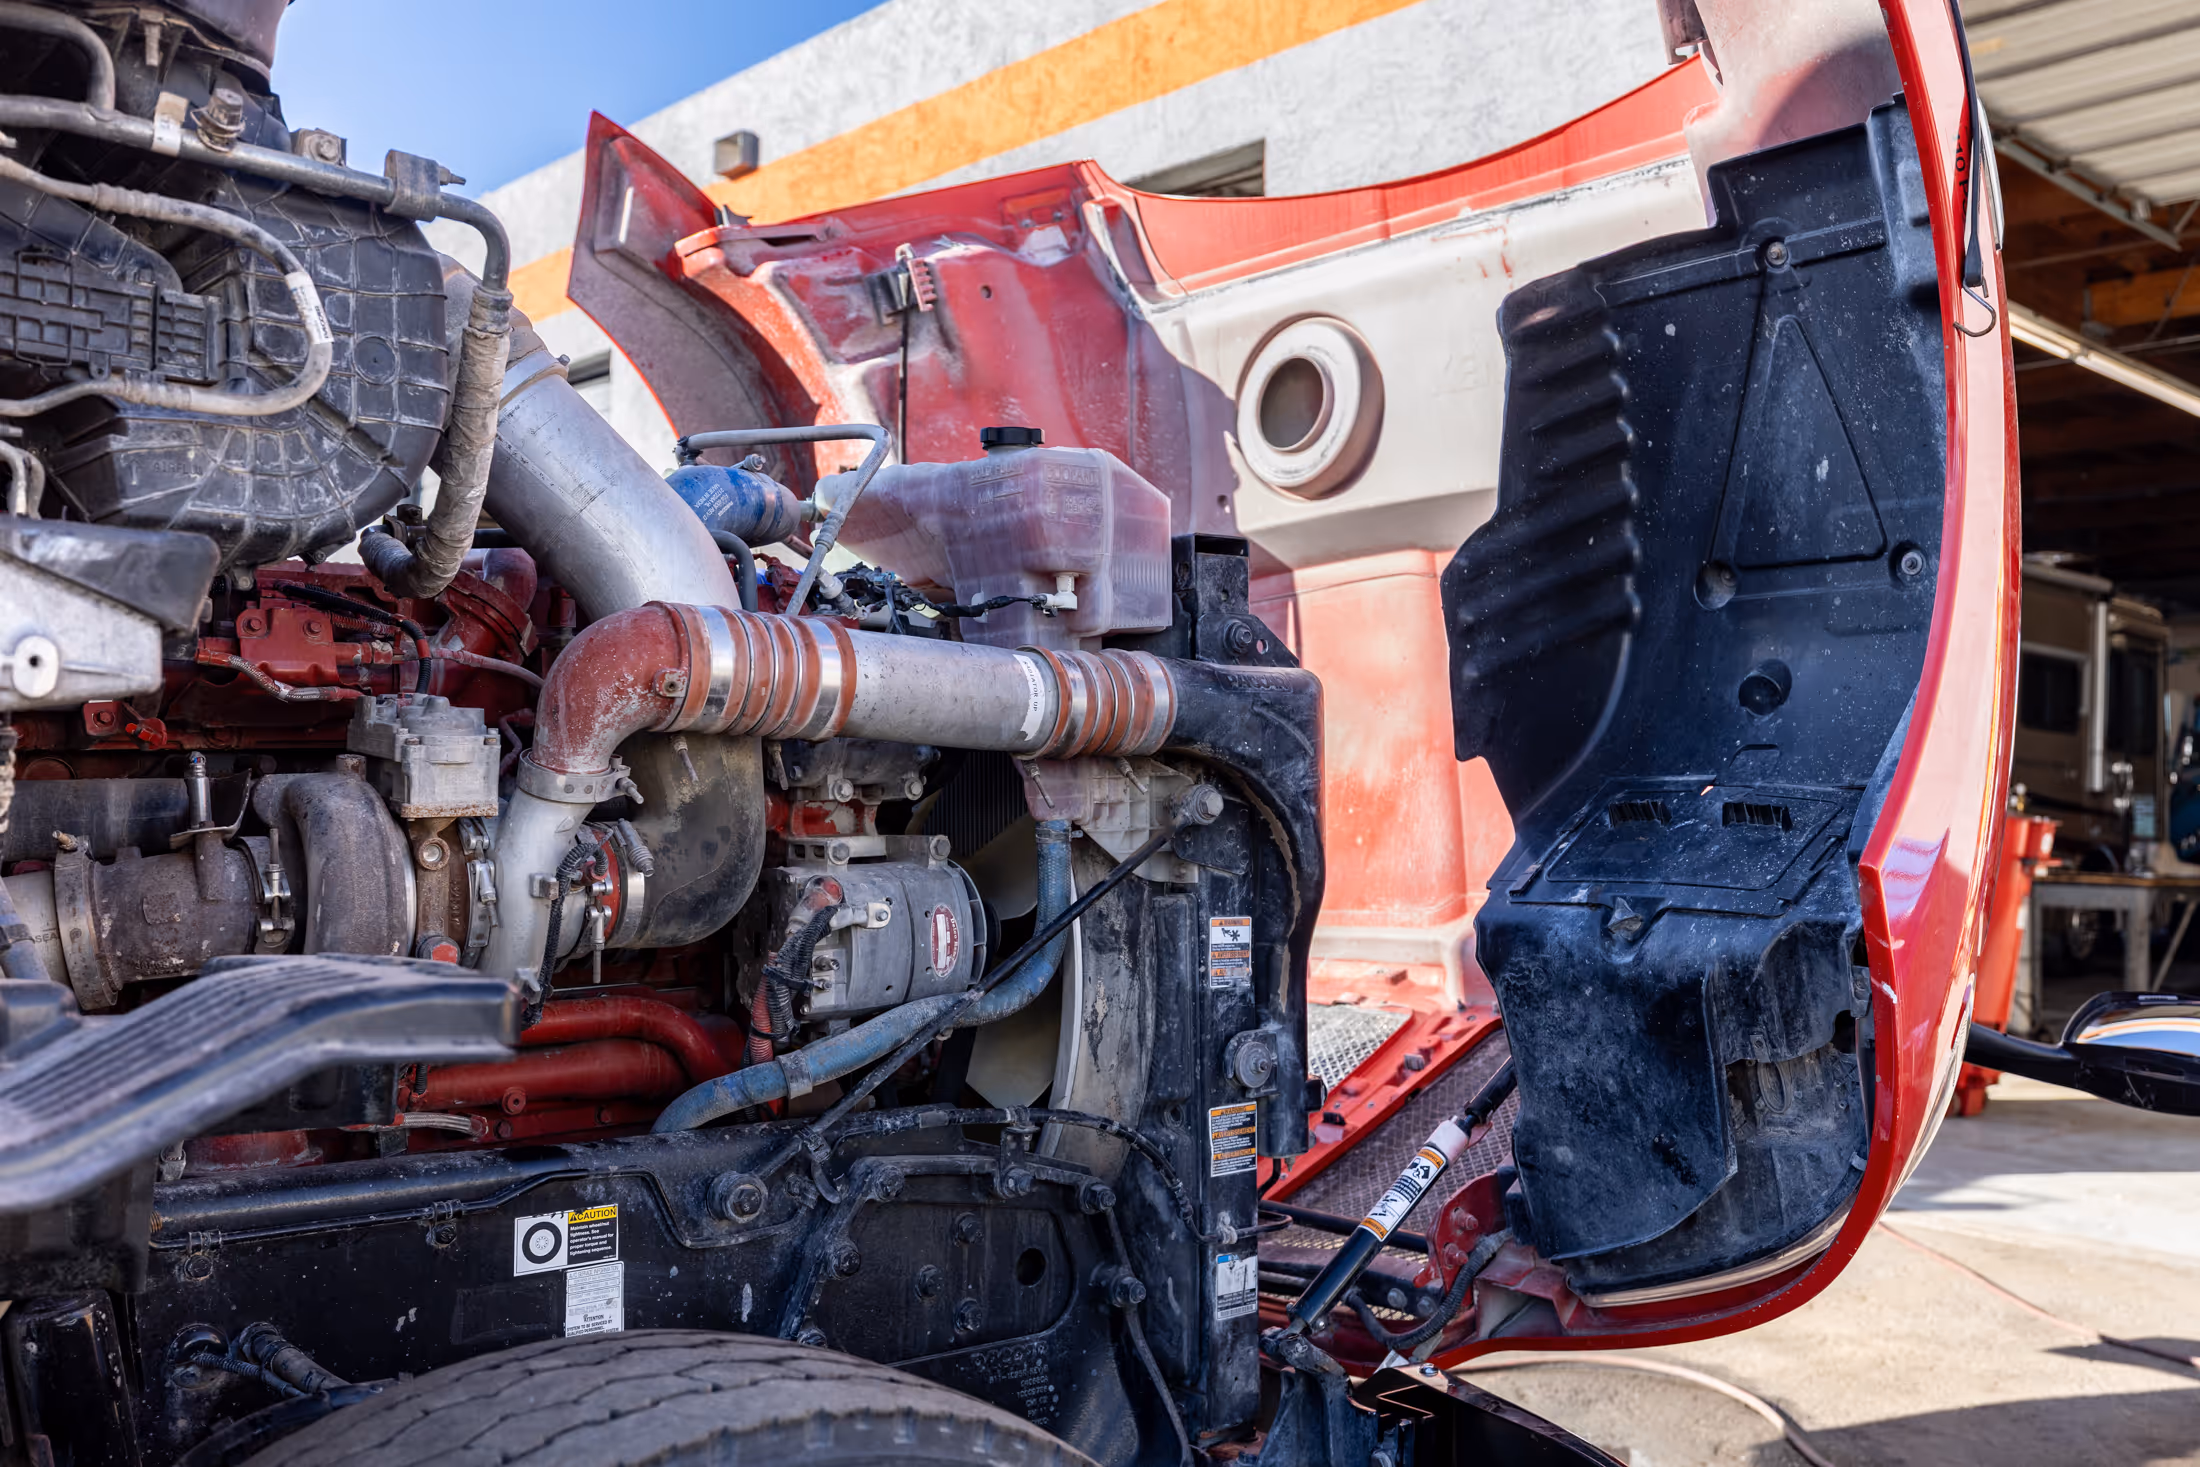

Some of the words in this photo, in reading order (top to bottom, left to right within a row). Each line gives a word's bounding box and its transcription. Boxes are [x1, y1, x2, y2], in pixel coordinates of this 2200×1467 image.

[1033, 702, 1038, 712] UP
[578, 1208, 617, 1221] CAUTION
[570, 1236, 591, 1244] operator's
[585, 1241, 599, 1249] torque
[570, 1248, 591, 1257] tightening
[584, 1314, 604, 1322] ATTENTION
